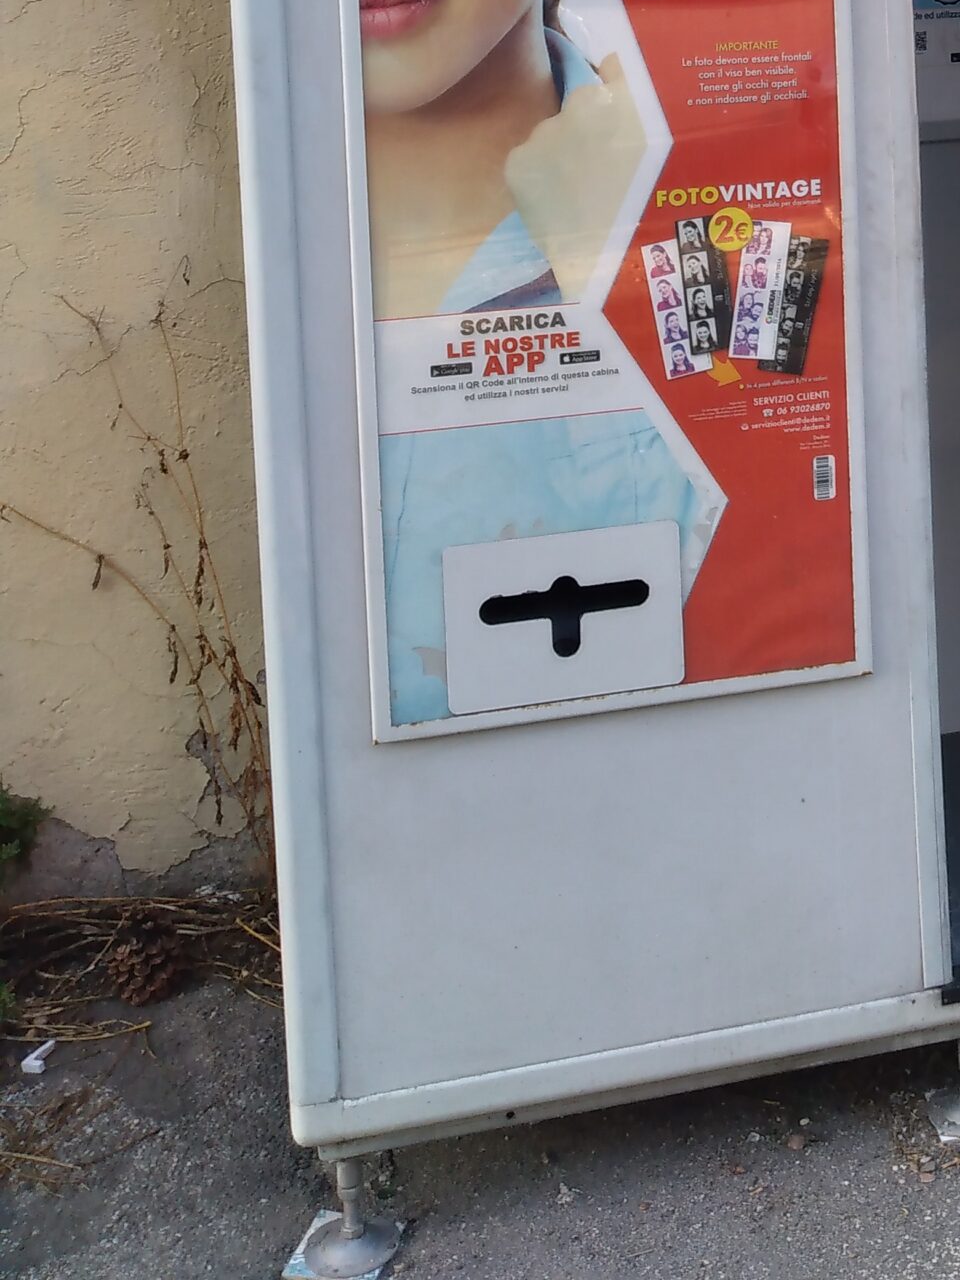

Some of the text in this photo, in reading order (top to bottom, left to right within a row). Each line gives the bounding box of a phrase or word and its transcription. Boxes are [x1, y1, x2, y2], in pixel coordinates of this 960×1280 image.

[924, 11, 934, 20] ed
[715, 40, 779, 52] IMPORTANTE
[682, 51, 812, 67] Le foto devono essere frontali
[698, 66, 796, 80] con il viso ben visibile.
[699, 78, 797, 93] Tenere gli occhi aperti
[695, 97, 713, 106] non
[715, 94, 758, 104] indossare
[760, 92, 771, 105] gli
[773, 91, 809, 101] occhiali.
[656, 178, 822, 208] FOTOVINTAGE
[714, 215, 749, 244] 2€
[460, 311, 567, 336] SCARICA
[447, 331, 580, 359] LE NOSTRE
[482, 351, 546, 377] APP
[411, 367, 619, 395] Scansiona il QR Code all'interno di questa cabina
[464, 392, 475, 402] ed
[477, 390, 507, 401] utilizza
[514, 387, 539, 397] nostri
[541, 383, 569, 394] servizi
[753, 390, 830, 407] SERVIZIO CLIENTI
[777, 407, 788, 415] 06
[751, 415, 831, 430] servizioclienti@dedem.it
[783, 422, 831, 433] www.dedem.it
